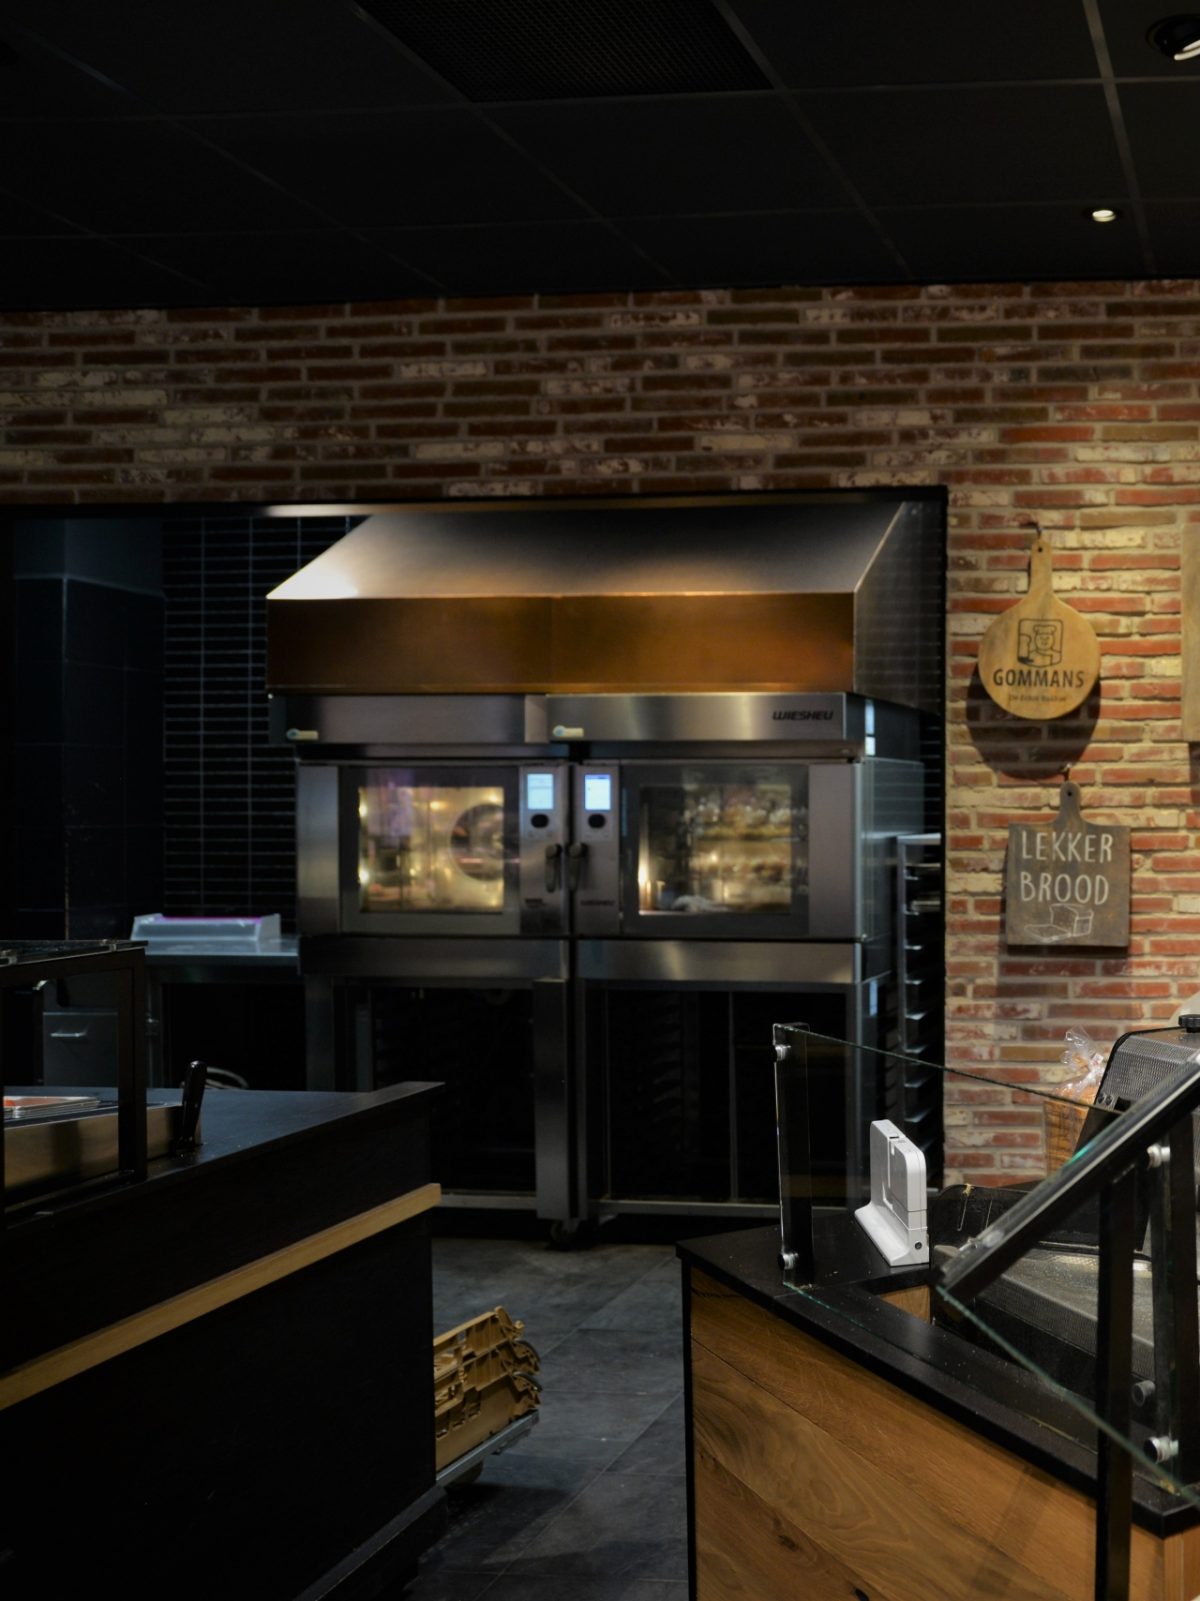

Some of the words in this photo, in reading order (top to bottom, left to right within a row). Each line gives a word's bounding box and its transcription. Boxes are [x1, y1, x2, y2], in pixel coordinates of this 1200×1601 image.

[992, 668, 1085, 688] GOMMANS
[772, 710, 834, 720] WIESHEU
[1021, 830, 1113, 864] LEKKER
[1020, 872, 1110, 904] BROOD
